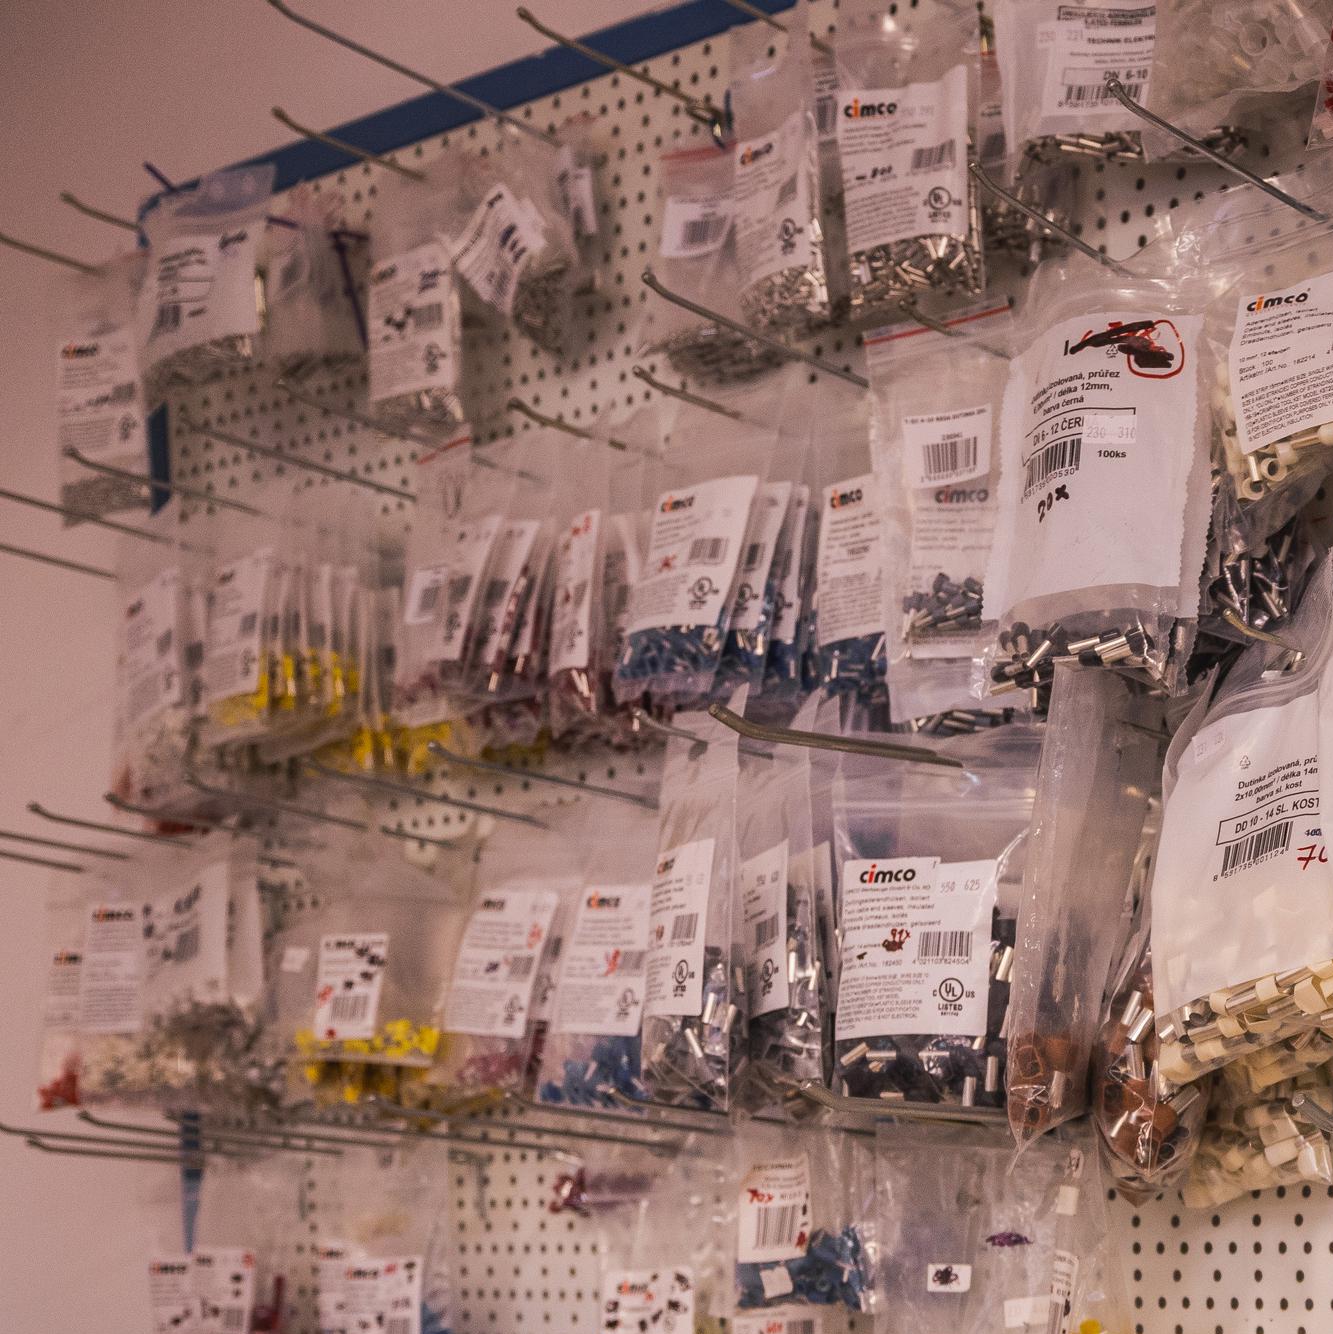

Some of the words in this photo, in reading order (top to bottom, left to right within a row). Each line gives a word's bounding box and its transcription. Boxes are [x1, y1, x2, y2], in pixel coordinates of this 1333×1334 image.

[844, 98, 897, 118] cimco
[1247, 292, 1308, 312] cimco
[1098, 450, 1126, 459] 100ks
[1235, 821, 1247, 834] DD
[860, 864, 916, 884] cimco
[938, 1003, 963, 1011] LISTED
